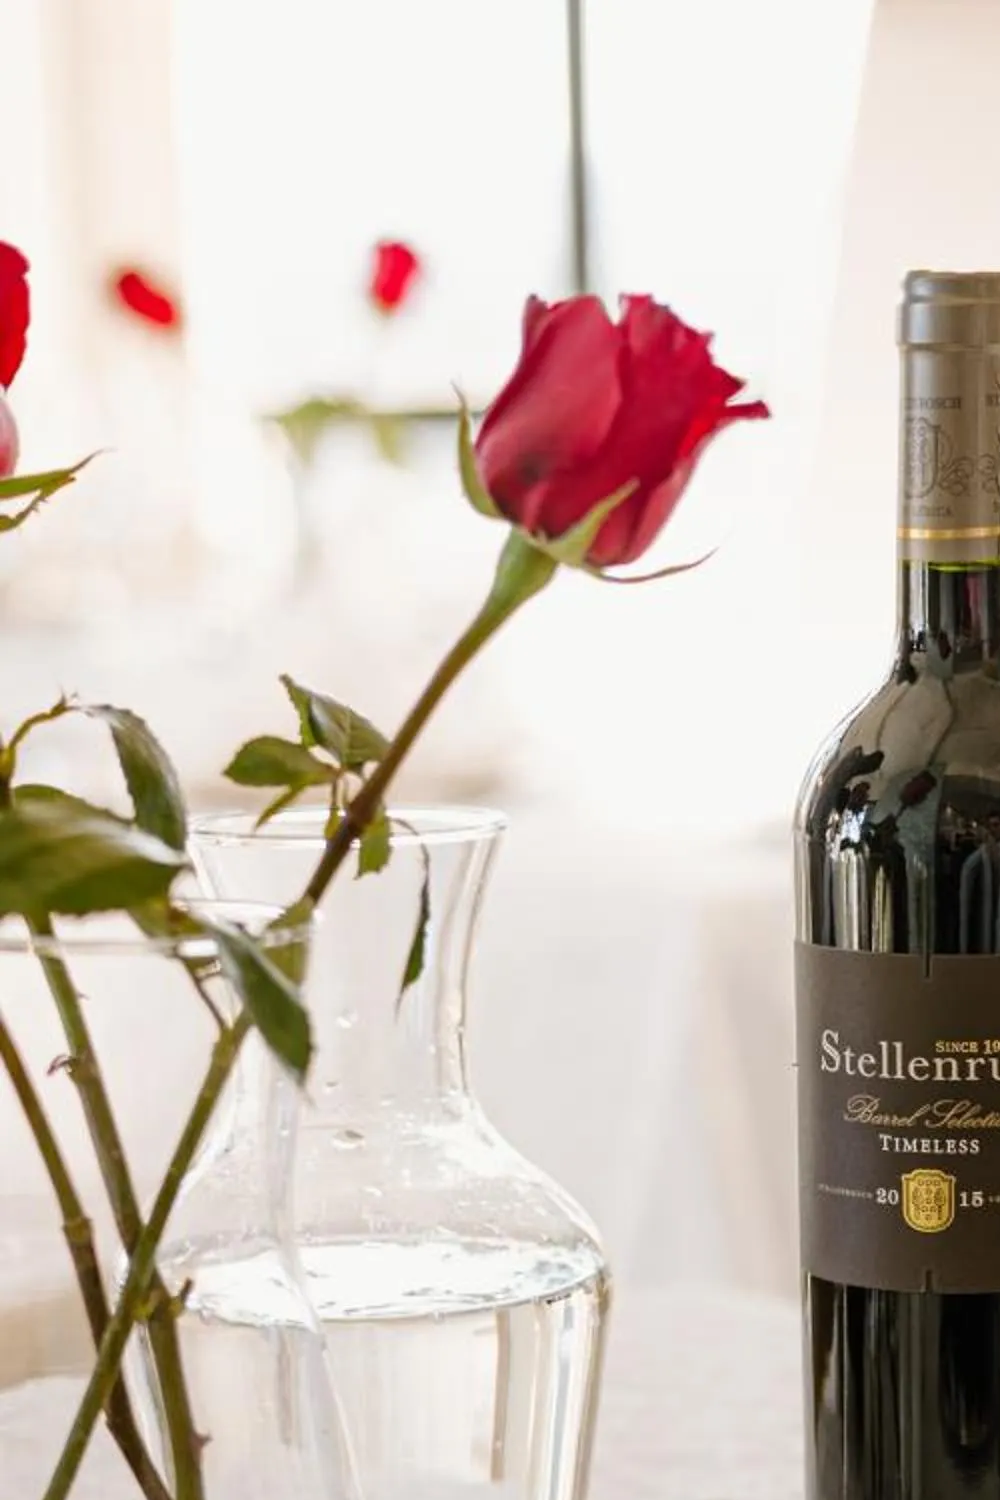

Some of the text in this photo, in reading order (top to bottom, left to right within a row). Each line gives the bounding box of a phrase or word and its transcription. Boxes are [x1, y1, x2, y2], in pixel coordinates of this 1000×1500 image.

[935, 1041, 979, 1054] SINCE
[843, 1094, 931, 1127] Barrel
[879, 1133, 980, 1155] TIMELESS
[876, 1187, 899, 1205] 20
[959, 1191, 984, 1208] 15
